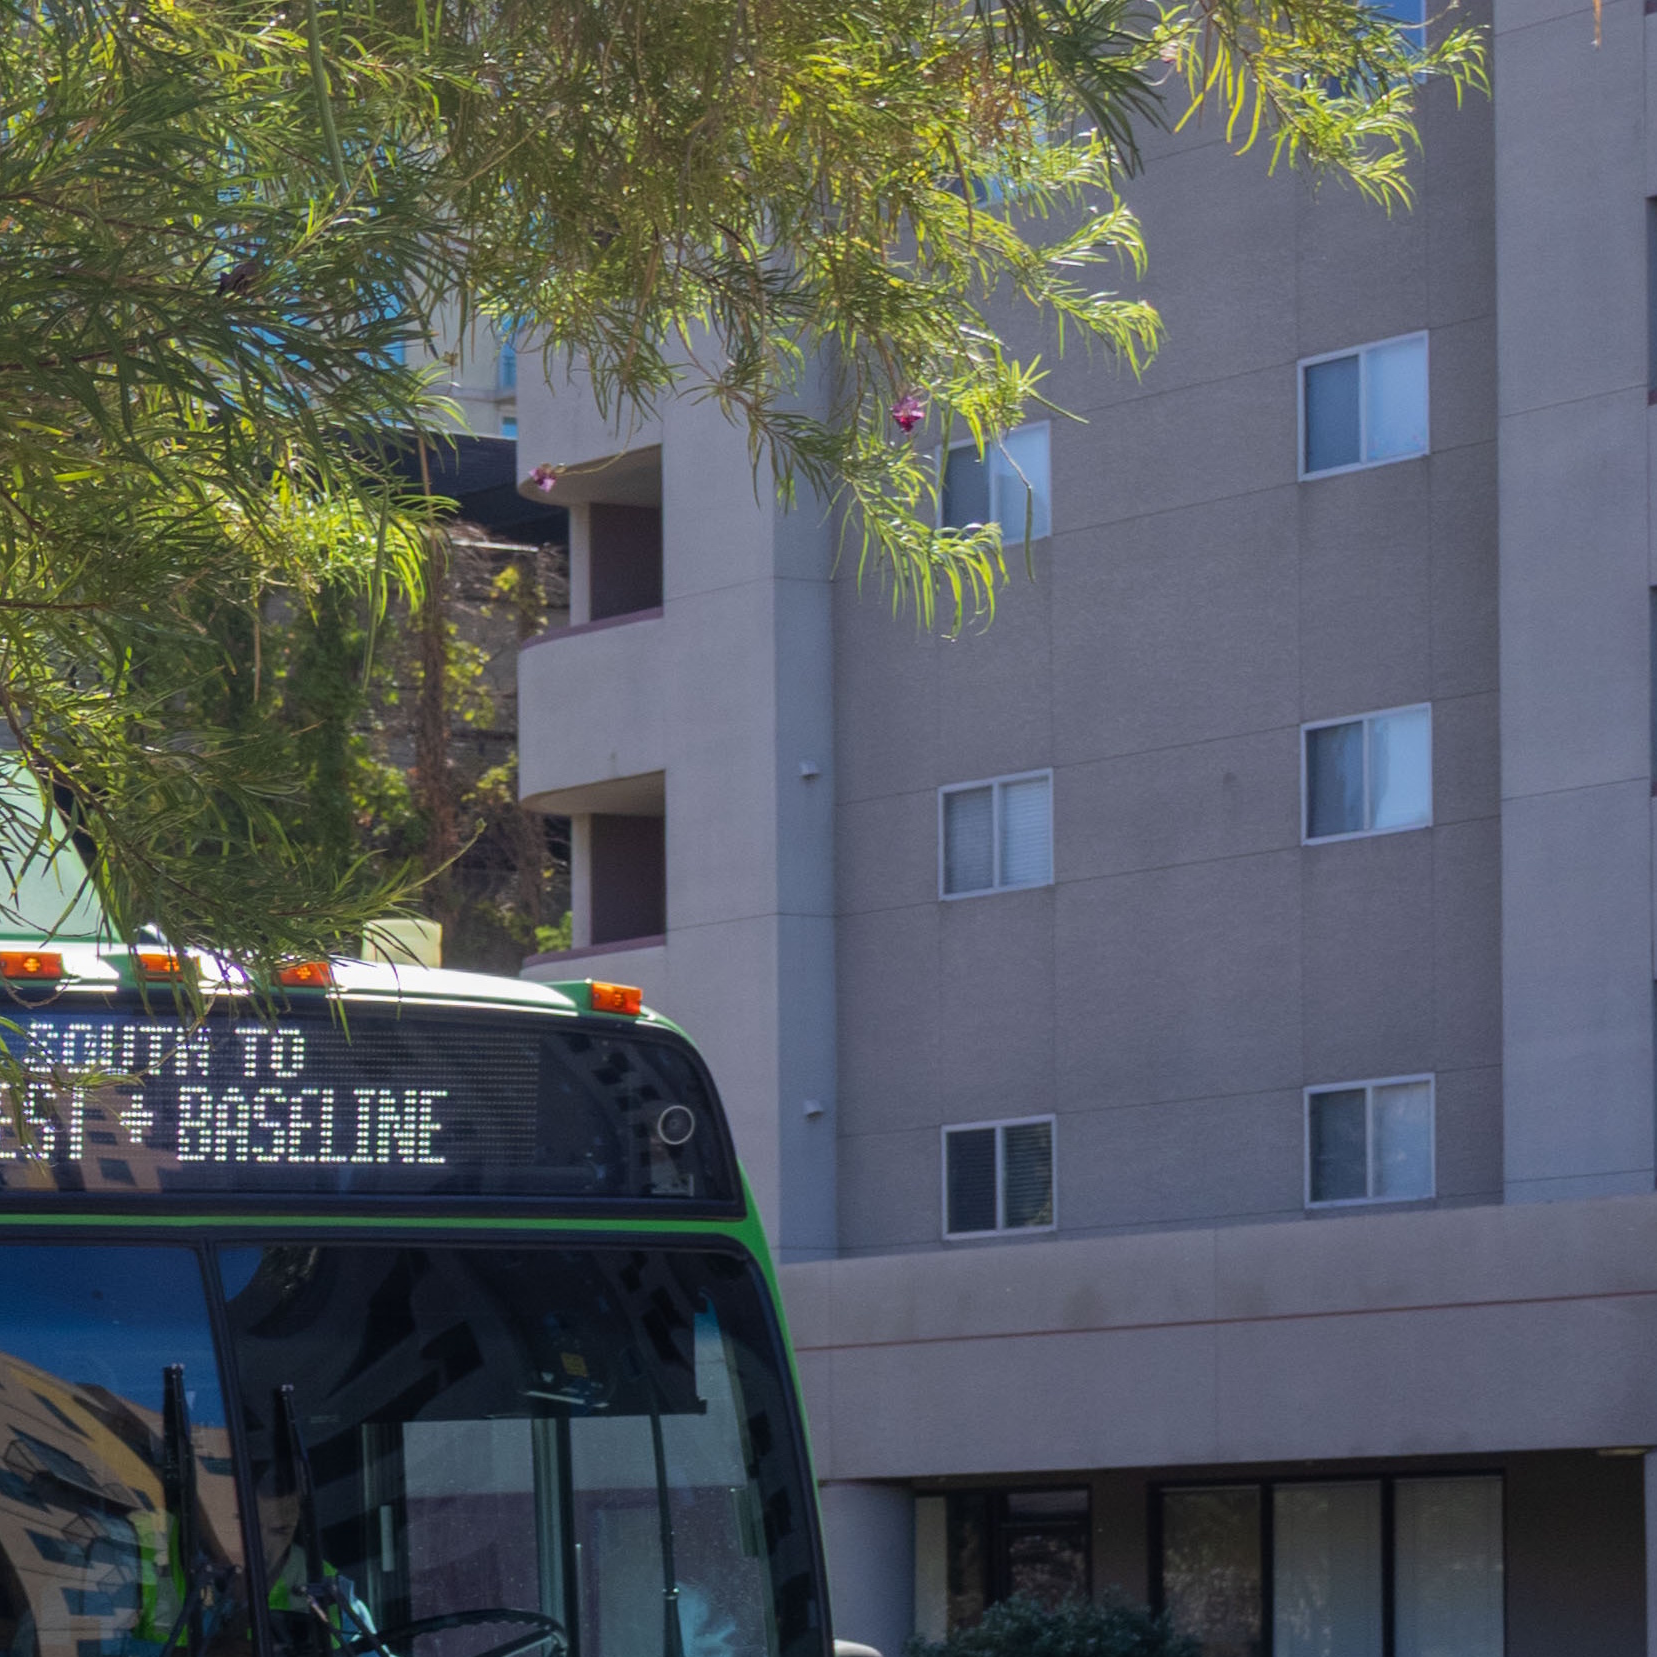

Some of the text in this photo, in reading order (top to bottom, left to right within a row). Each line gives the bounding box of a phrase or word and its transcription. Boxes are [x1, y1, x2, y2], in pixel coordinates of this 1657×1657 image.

[23, 1022, 305, 1078] SOUTH TO
[177, 1086, 449, 1164] BASELINE
